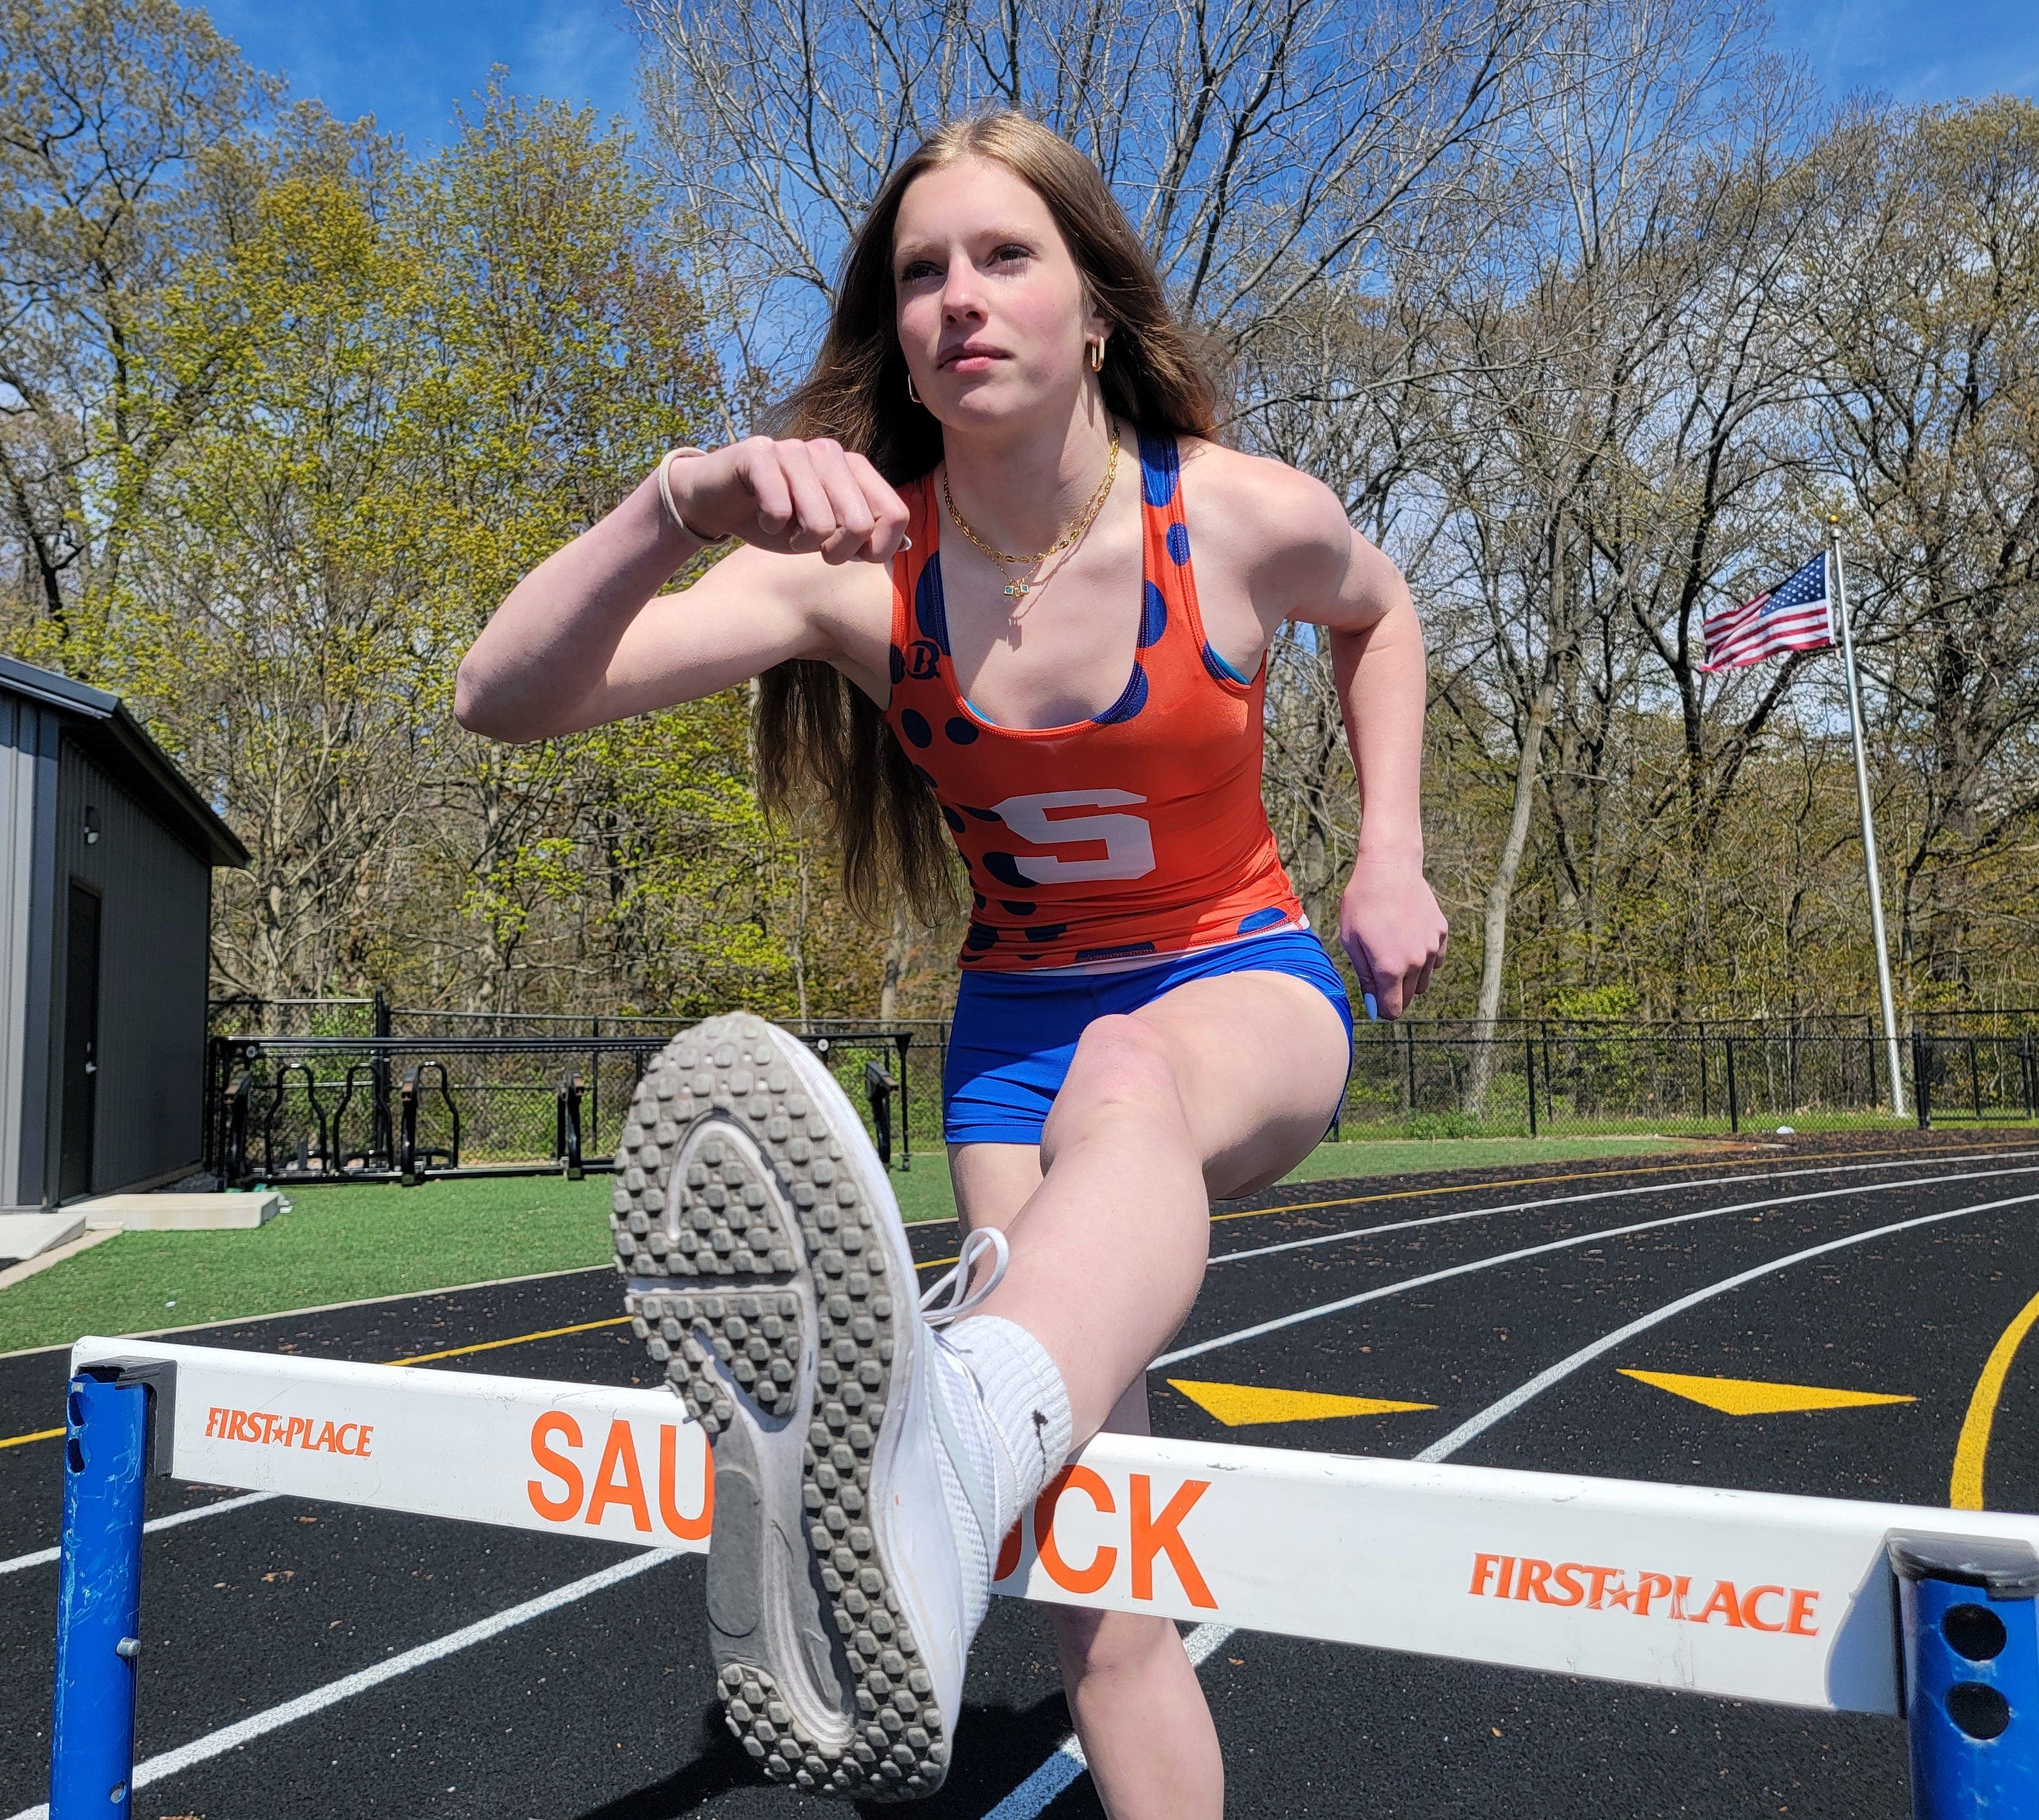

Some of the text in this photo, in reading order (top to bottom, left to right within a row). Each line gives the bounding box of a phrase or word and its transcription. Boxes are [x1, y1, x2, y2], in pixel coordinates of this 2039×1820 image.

[906, 640, 940, 680] B
[989, 788, 1156, 885] S
[204, 1407, 374, 1458] FIRST PLACE
[1467, 1552, 1618, 1610] FIRST
